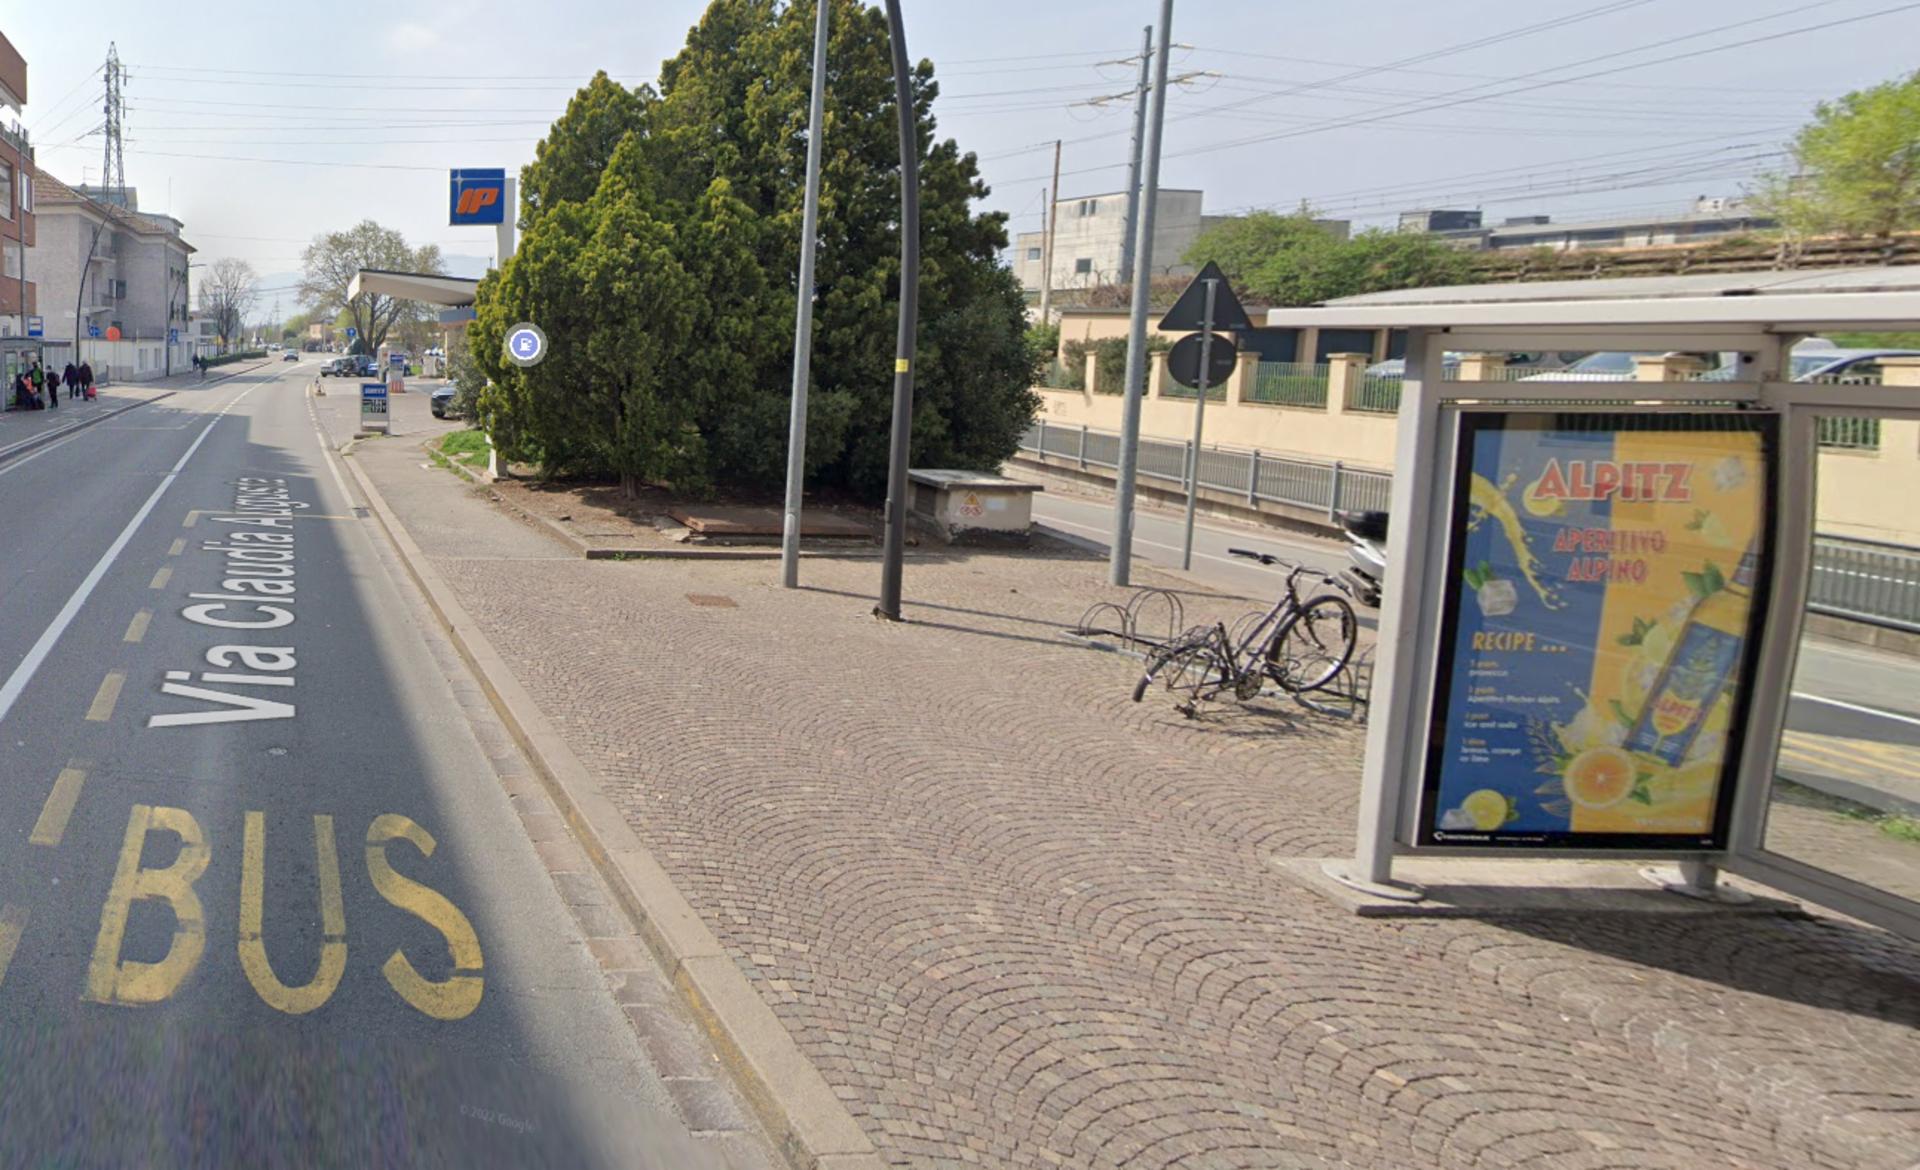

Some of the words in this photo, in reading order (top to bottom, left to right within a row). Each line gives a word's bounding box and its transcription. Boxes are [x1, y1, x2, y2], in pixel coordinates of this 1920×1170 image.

[456, 188, 499, 214] IP
[1531, 456, 1693, 502] ALPITZ
[1554, 527, 1667, 553] APERITIVO
[1567, 557, 1648, 584] ALPINO
[1472, 631, 1536, 652] RECIPE
[82, 804, 484, 1020] BUS
